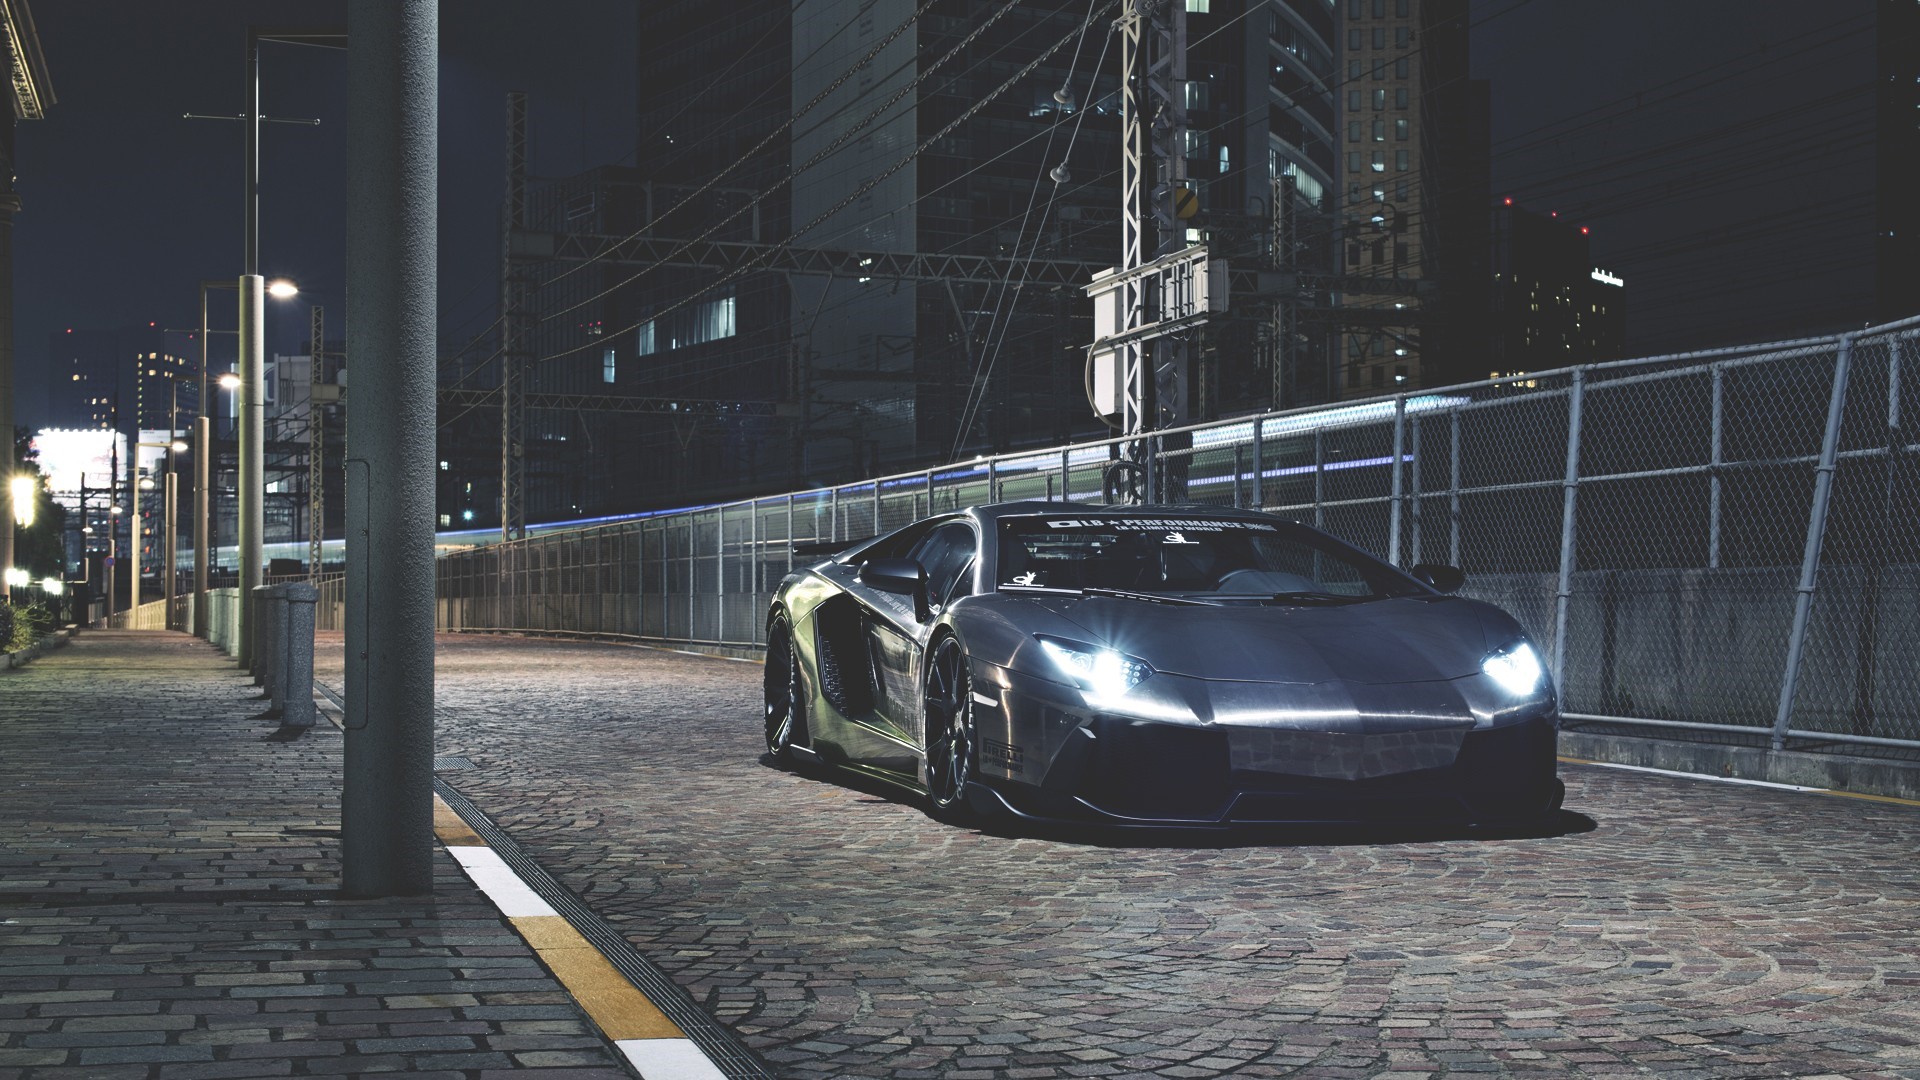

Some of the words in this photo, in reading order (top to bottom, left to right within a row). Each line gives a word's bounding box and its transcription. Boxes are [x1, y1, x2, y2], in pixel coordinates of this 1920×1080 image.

[1080, 519, 1104, 527] LB
[1122, 519, 1245, 529] PERFORMANCE
[983, 737, 1024, 763] PIRELLI
